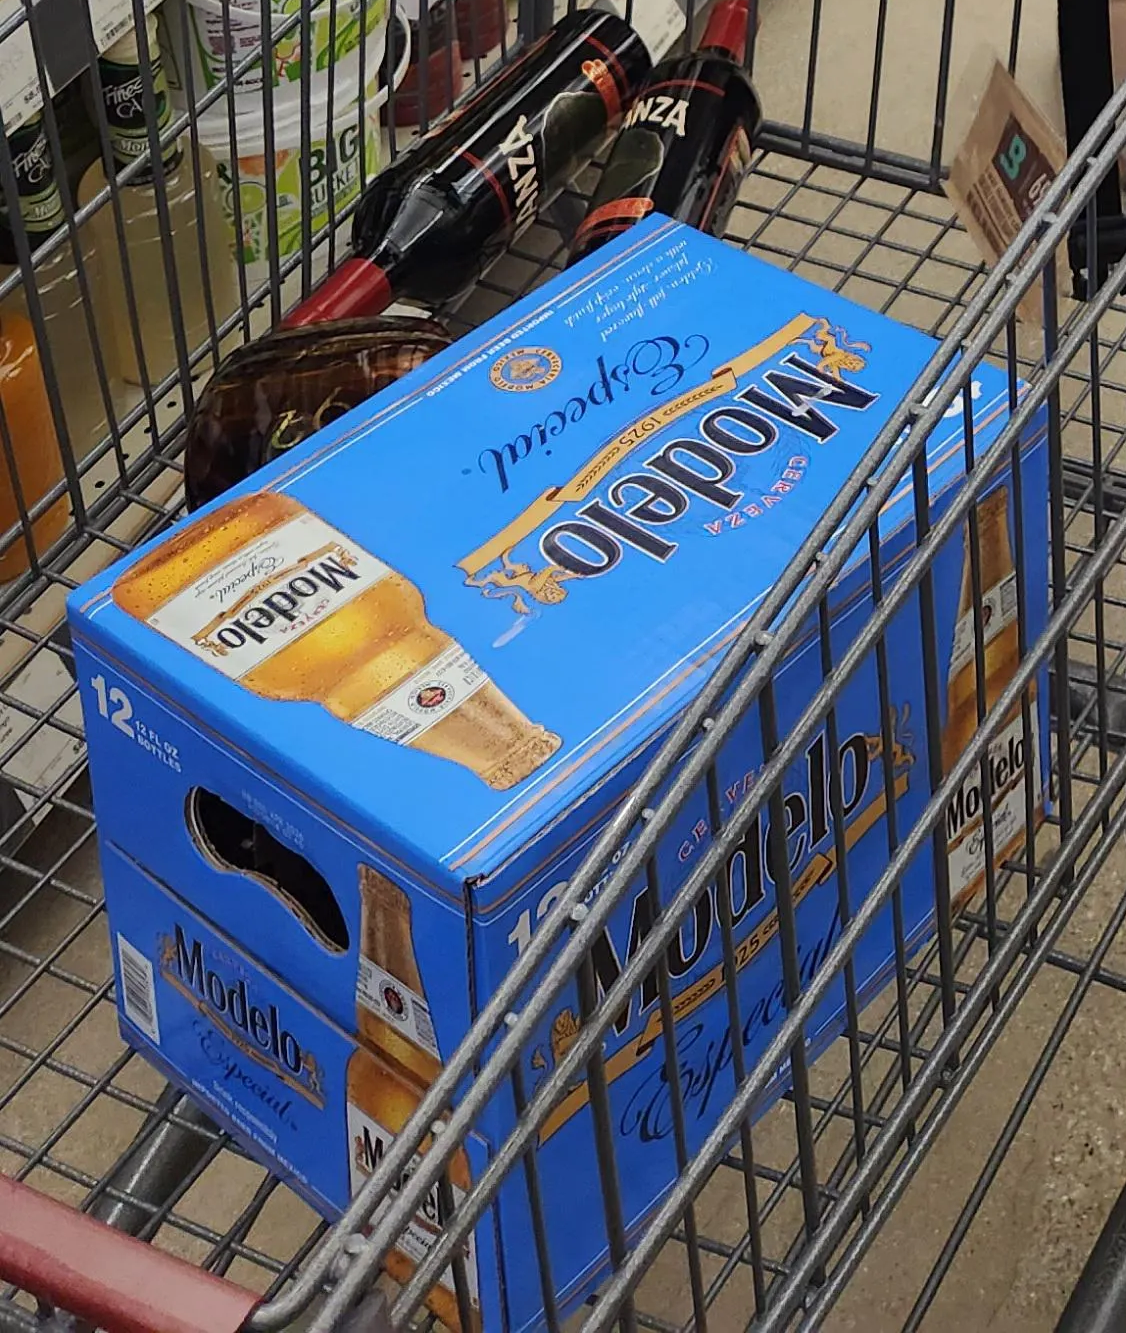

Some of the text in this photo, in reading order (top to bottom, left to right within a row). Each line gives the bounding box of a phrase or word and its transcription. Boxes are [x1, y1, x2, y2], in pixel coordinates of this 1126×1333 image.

[665, 239, 688, 261] with
[564, 298, 595, 328] finish
[426, 309, 555, 397] IMPORTED BEER FROM MEXICO
[476, 333, 710, 494] Especial
[618, 414, 663, 447] 1925
[538, 350, 883, 578] Modelo
[702, 454, 812, 537] CERVEZA
[215, 555, 286, 605] Especial
[216, 554, 362, 650] Modelo
[91, 674, 135, 740] 12
[135, 719, 181, 760] 12 FL OZ
[137, 733, 183, 775] BOTTLES
[588, 732, 871, 1037] Modelo
[174, 922, 305, 1077] Modelo
